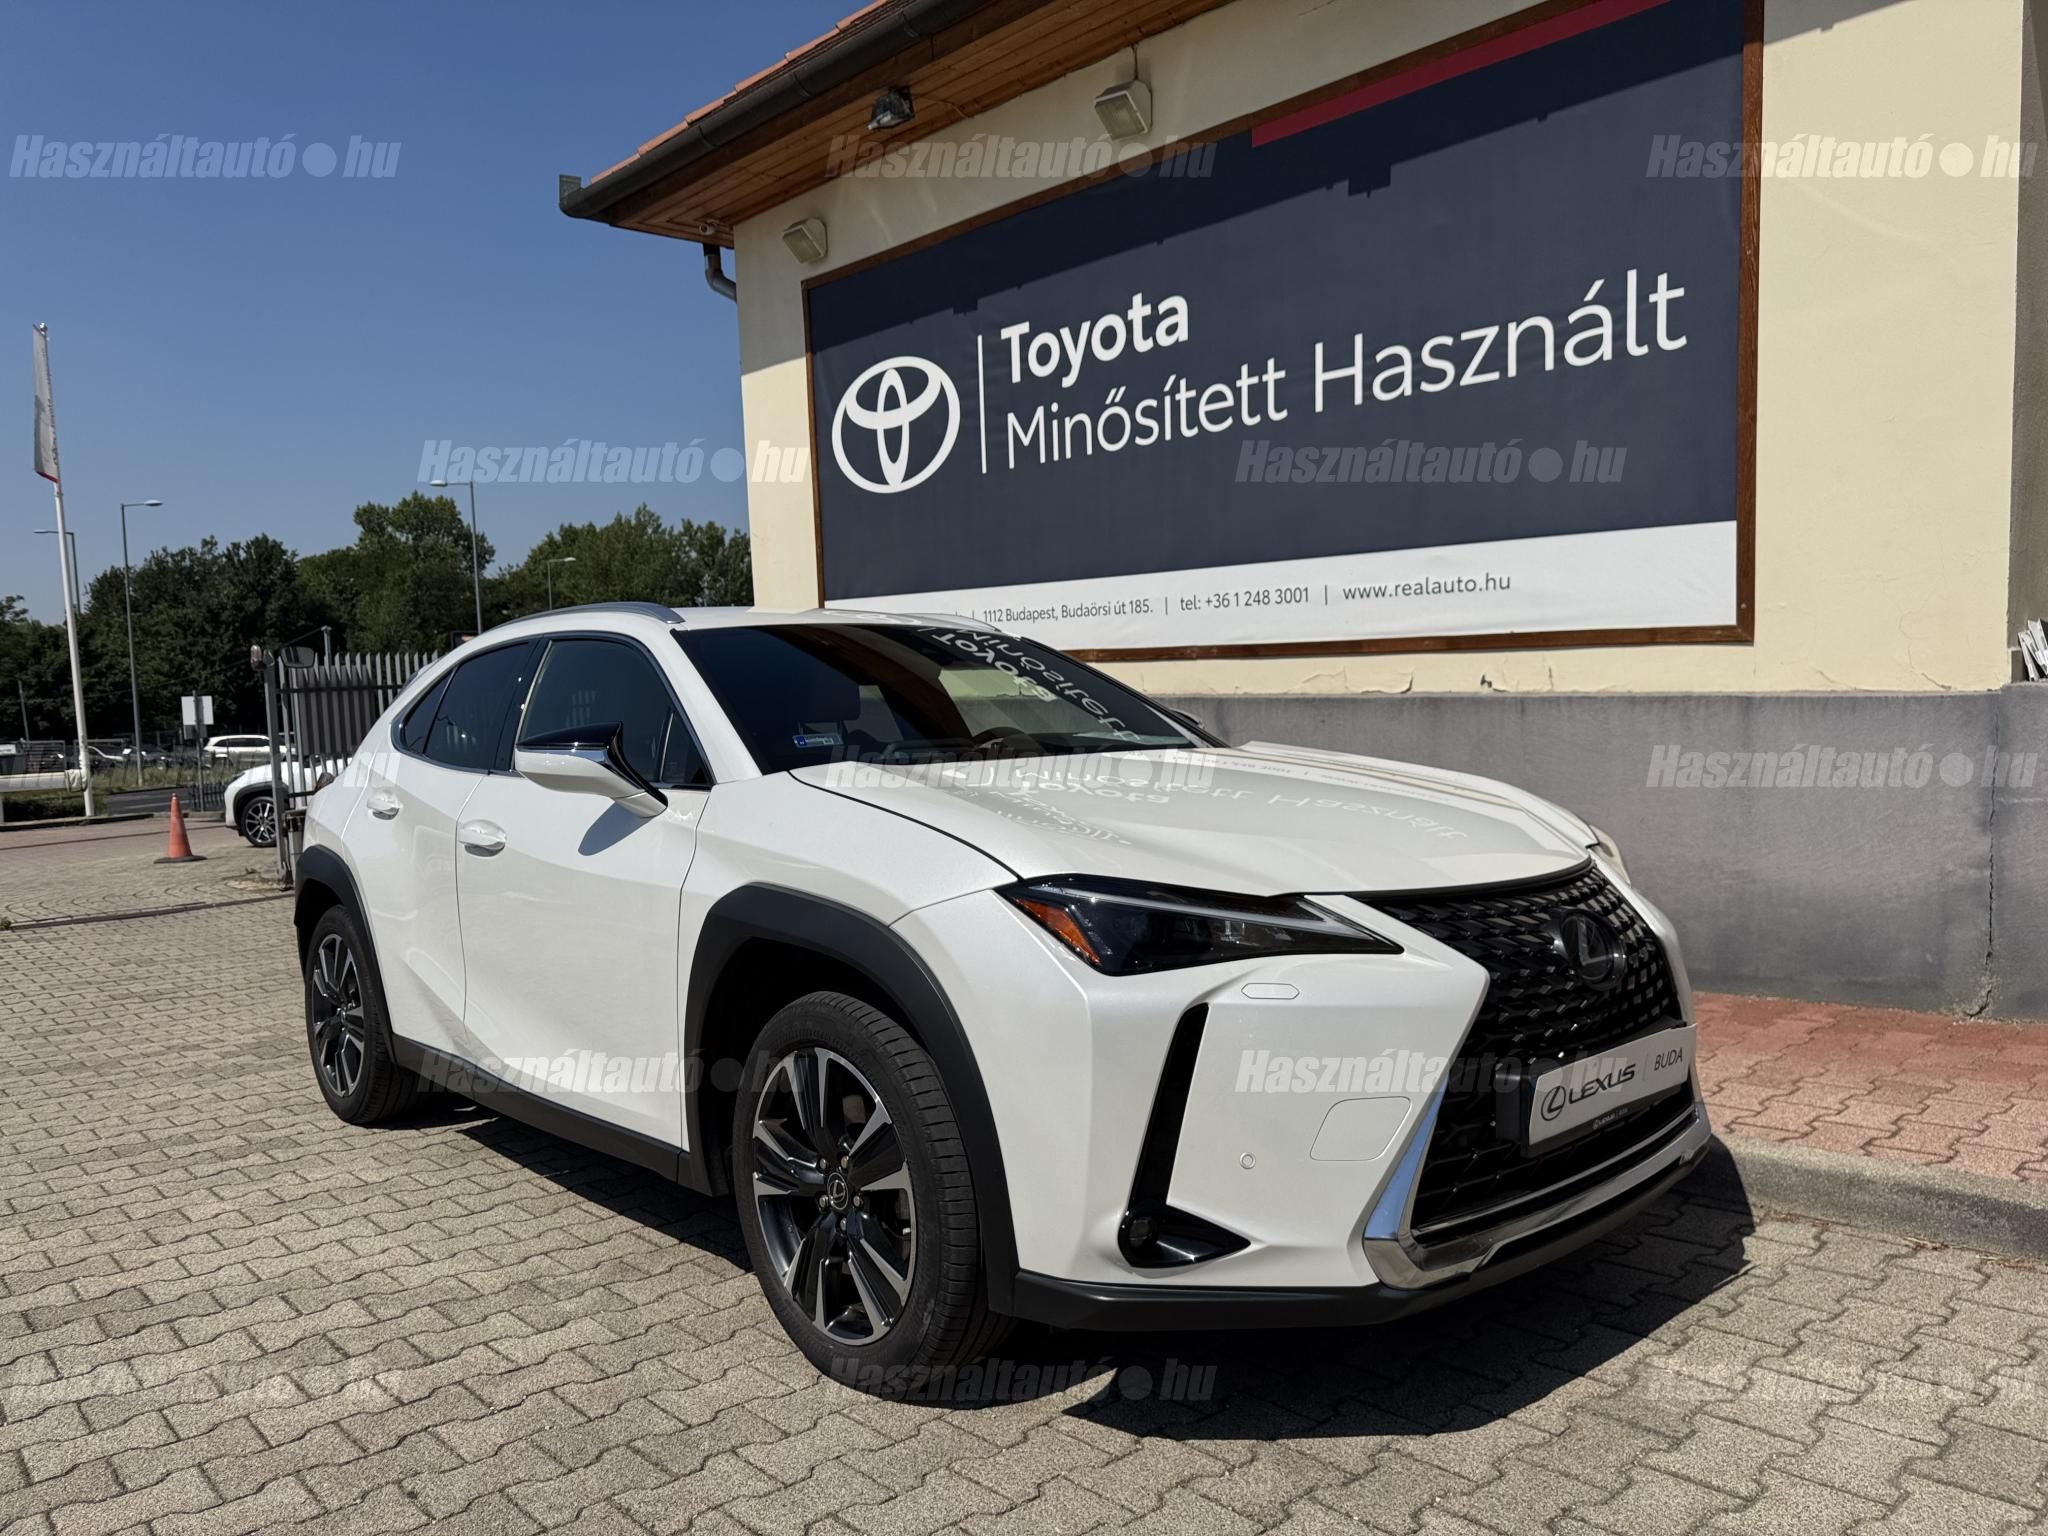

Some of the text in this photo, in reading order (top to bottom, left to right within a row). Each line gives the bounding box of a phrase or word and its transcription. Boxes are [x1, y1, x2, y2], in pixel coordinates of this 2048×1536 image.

[1000, 292, 1189, 388] Toyota
[1006, 269, 1688, 470] Minősített Használt
[983, 572, 1512, 624] 1112 Budapest, Budaörsi út 185. tel: +36 1 248 3001 www.realauto.hu
[1568, 1047, 1684, 1104] LEXUS BUDA
